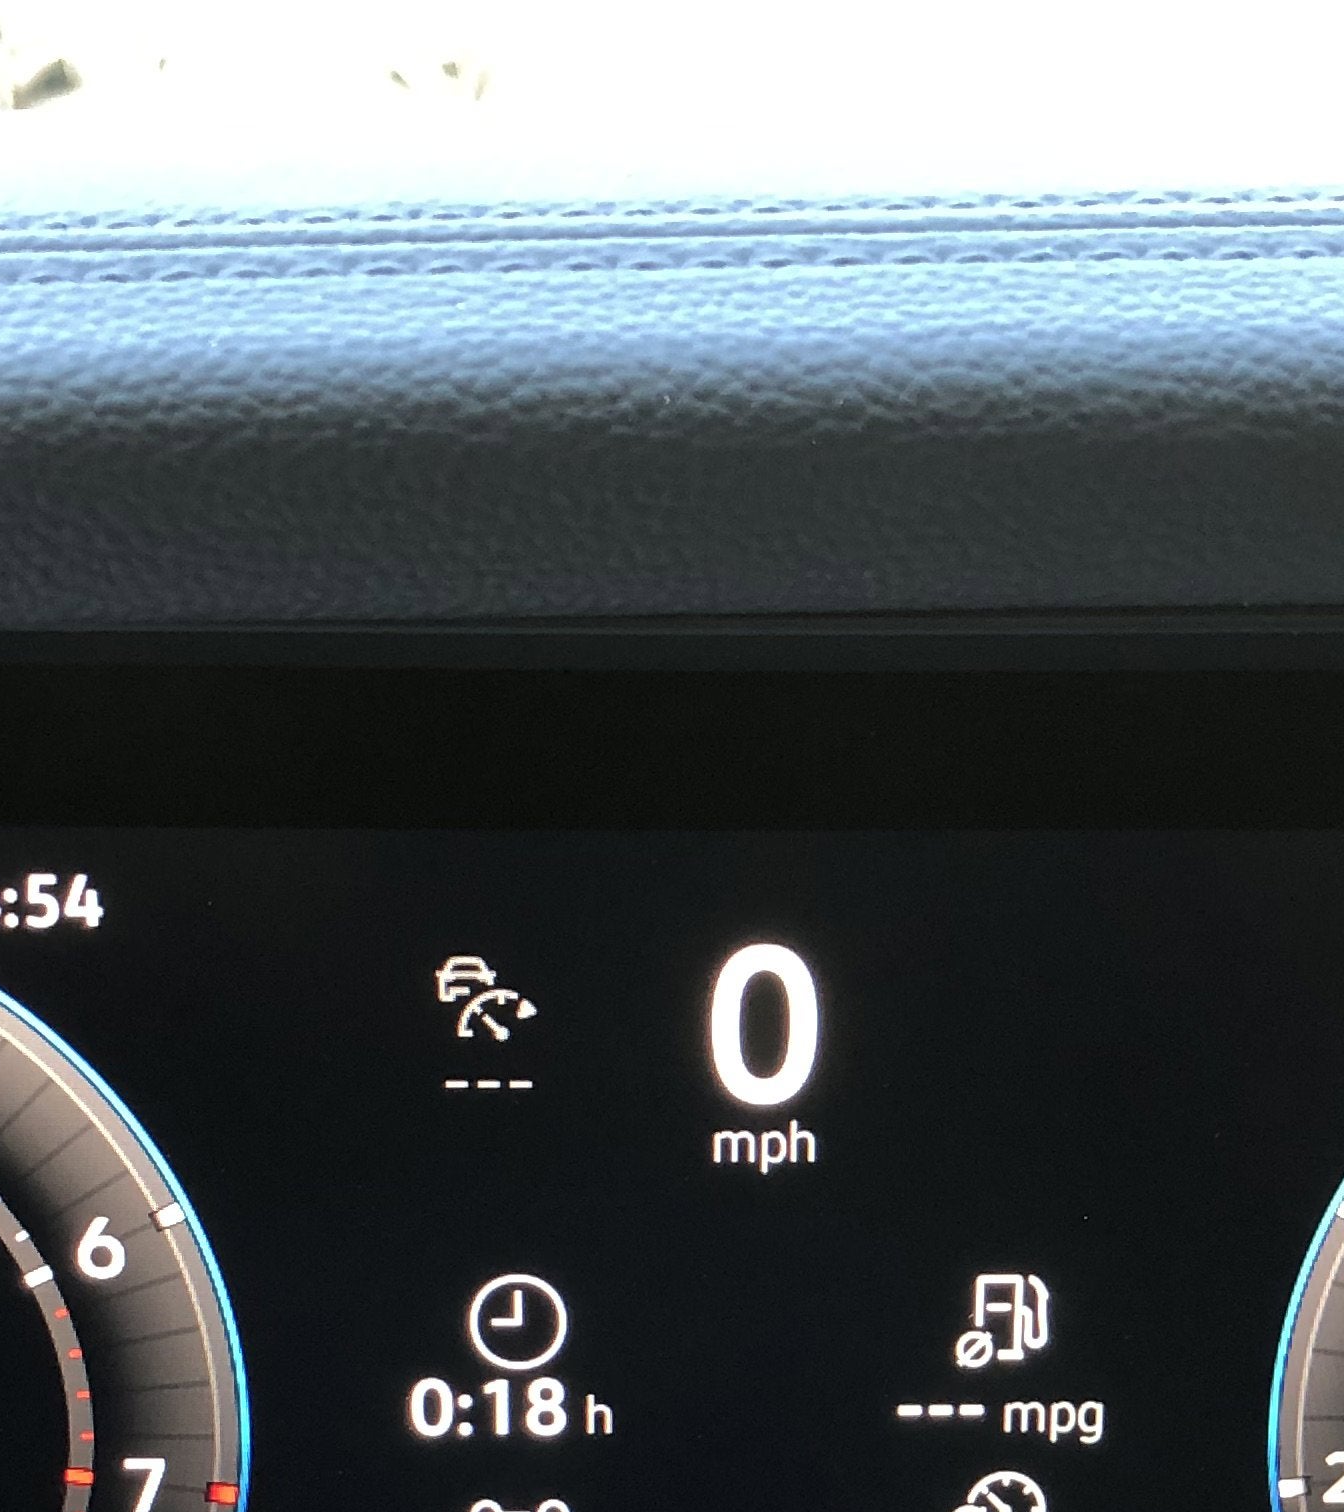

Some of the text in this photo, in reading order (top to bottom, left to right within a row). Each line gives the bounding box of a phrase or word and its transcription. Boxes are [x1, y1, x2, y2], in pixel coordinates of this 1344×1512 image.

[708, 943, 820, 1107] 0
[713, 1120, 816, 1174] mph
[77, 1217, 125, 1279] 6
[407, 1376, 613, 1437] 0:18 h
[1002, 1401, 1104, 1444] mpg
